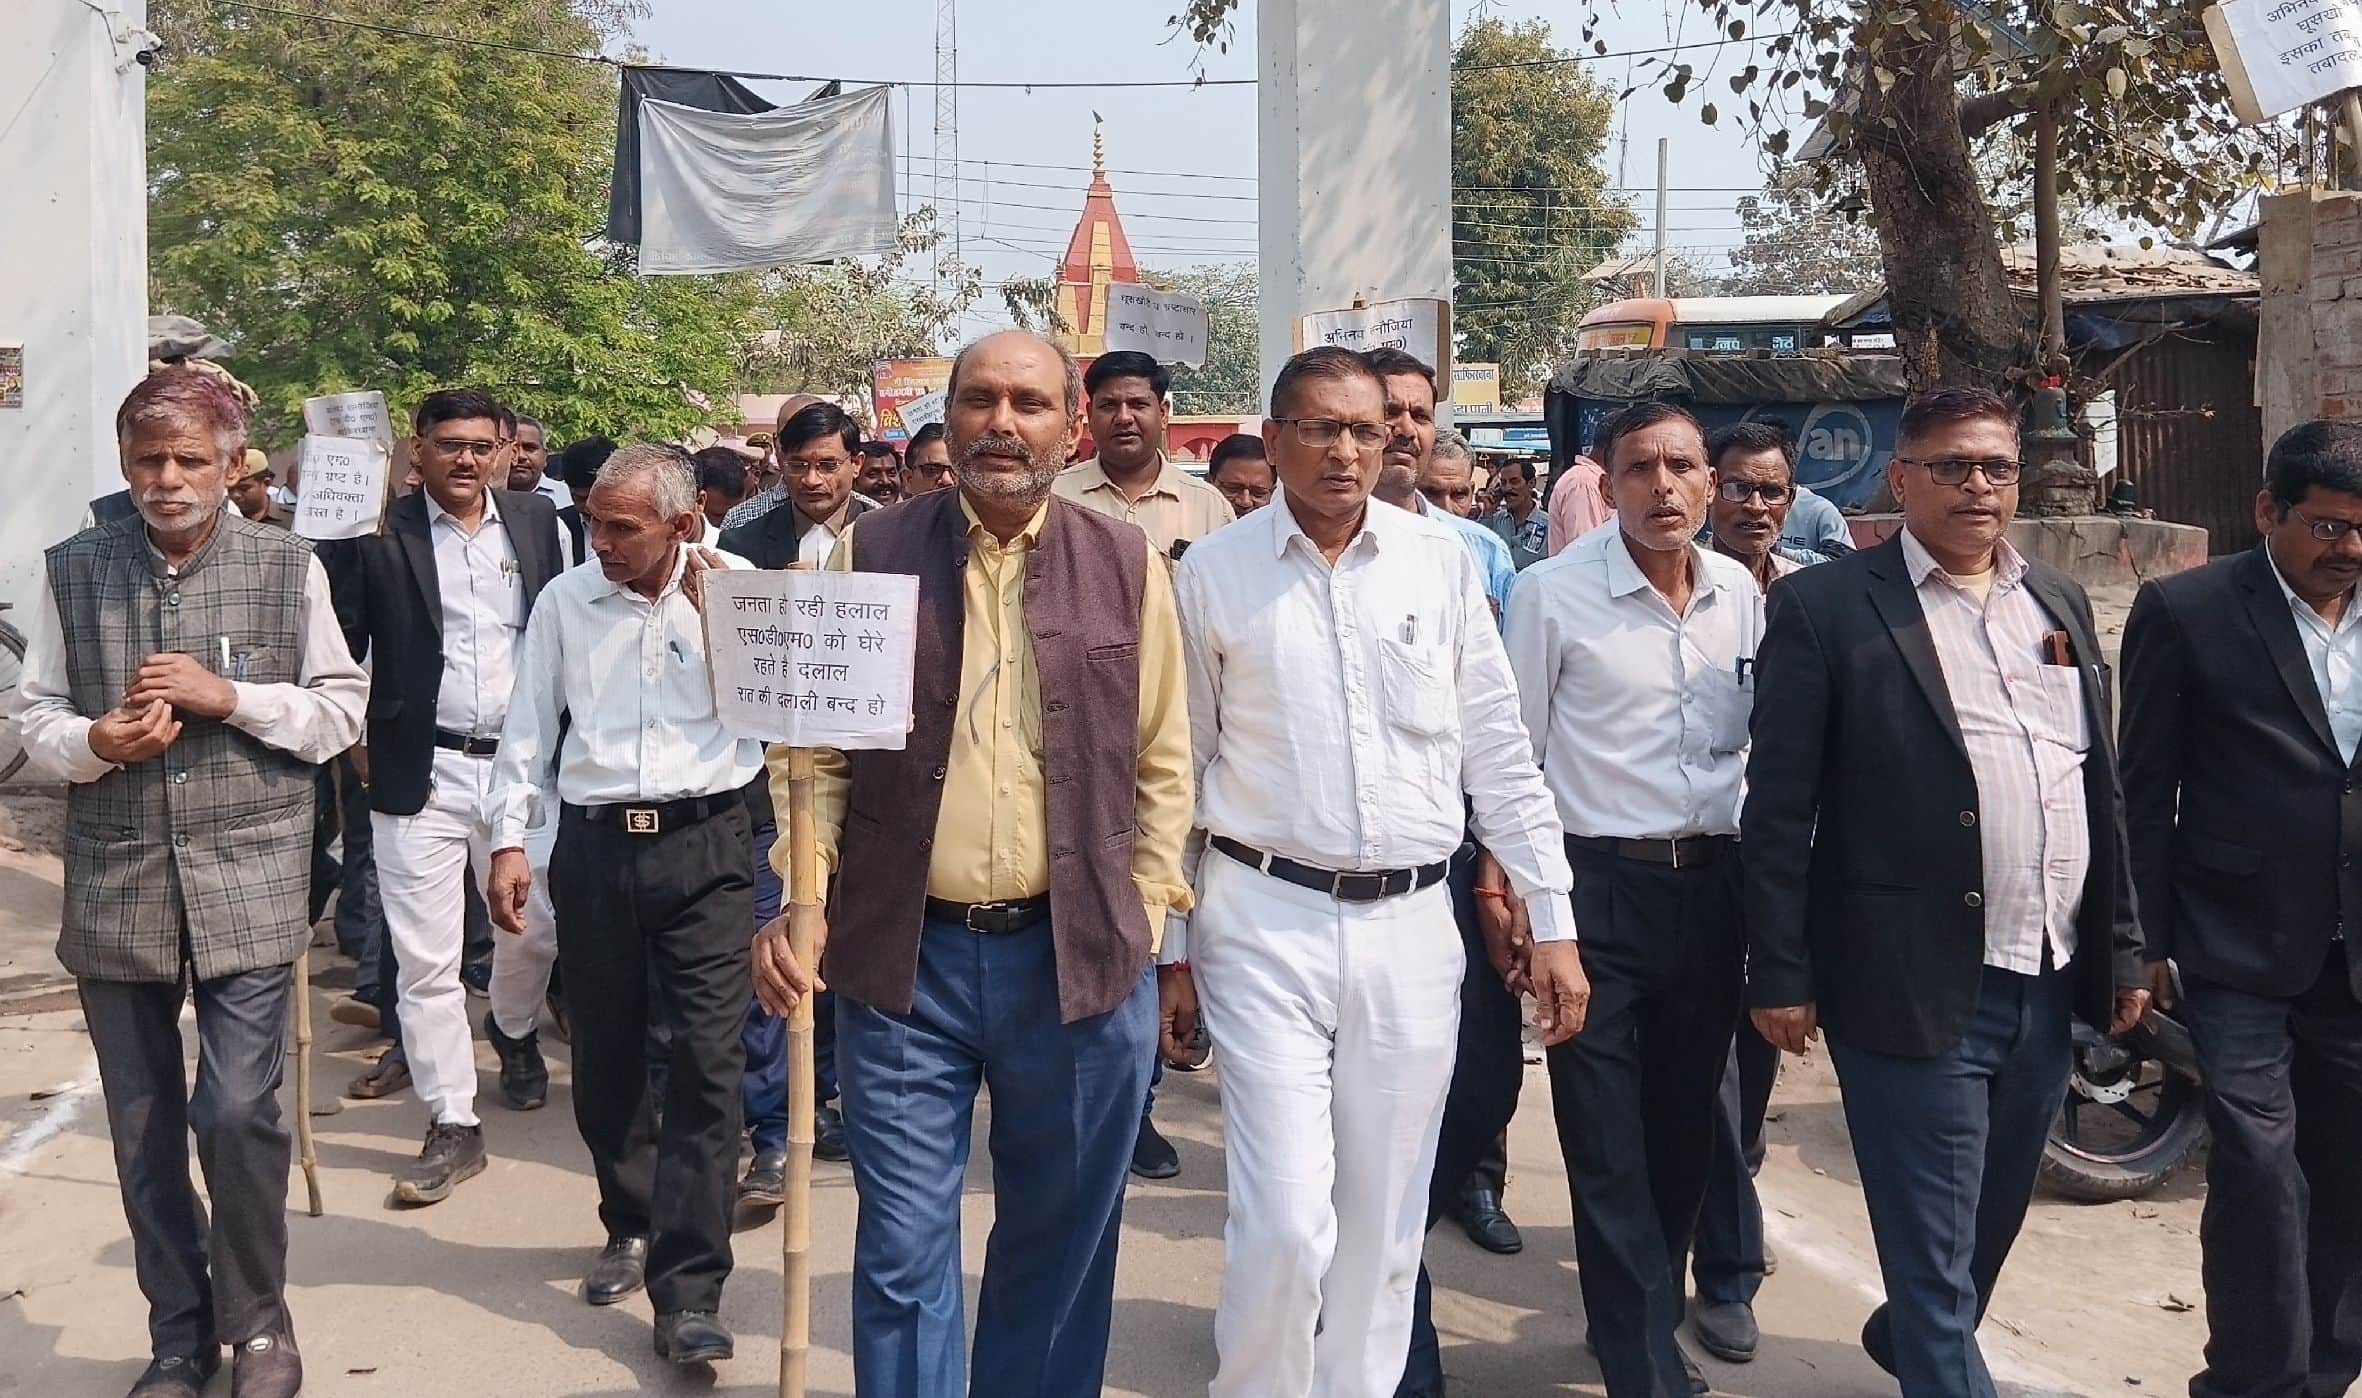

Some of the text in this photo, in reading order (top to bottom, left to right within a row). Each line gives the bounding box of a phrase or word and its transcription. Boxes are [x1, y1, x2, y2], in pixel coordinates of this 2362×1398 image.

[2278, 37, 2325, 65] इसका
[731, 596, 772, 614] जनता
[795, 594, 826, 617] रही
[834, 601, 890, 621] हलाल
[824, 628, 848, 651] को
[857, 629, 886, 653] घेरे
[753, 653, 776, 676] रहते
[797, 662, 849, 682] दलाल
[737, 685, 887, 716] रात की दलाली बन्द हो
